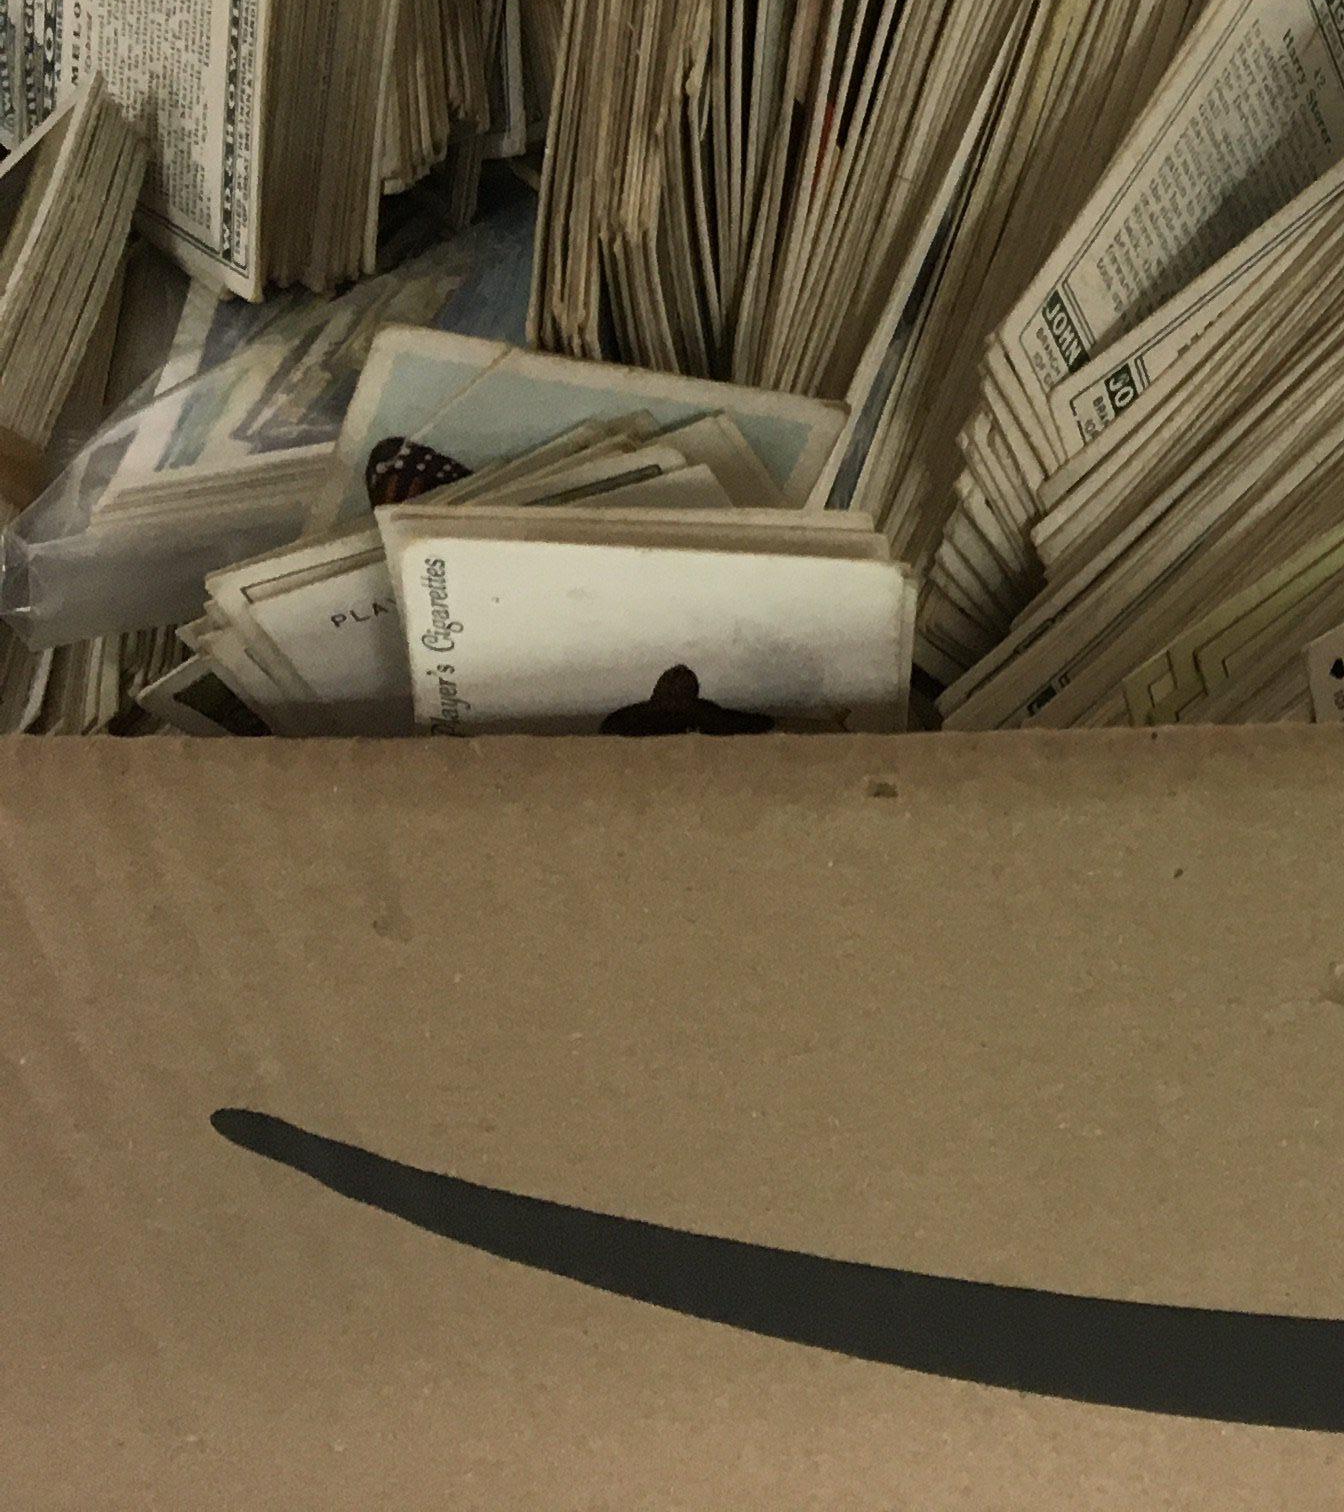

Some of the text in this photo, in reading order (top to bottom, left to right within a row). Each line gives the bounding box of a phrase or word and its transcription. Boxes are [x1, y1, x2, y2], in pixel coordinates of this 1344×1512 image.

[1041, 303, 1086, 366] JOHN
[1104, 371, 1139, 408] JO
[423, 558, 463, 653] Cigarettes
